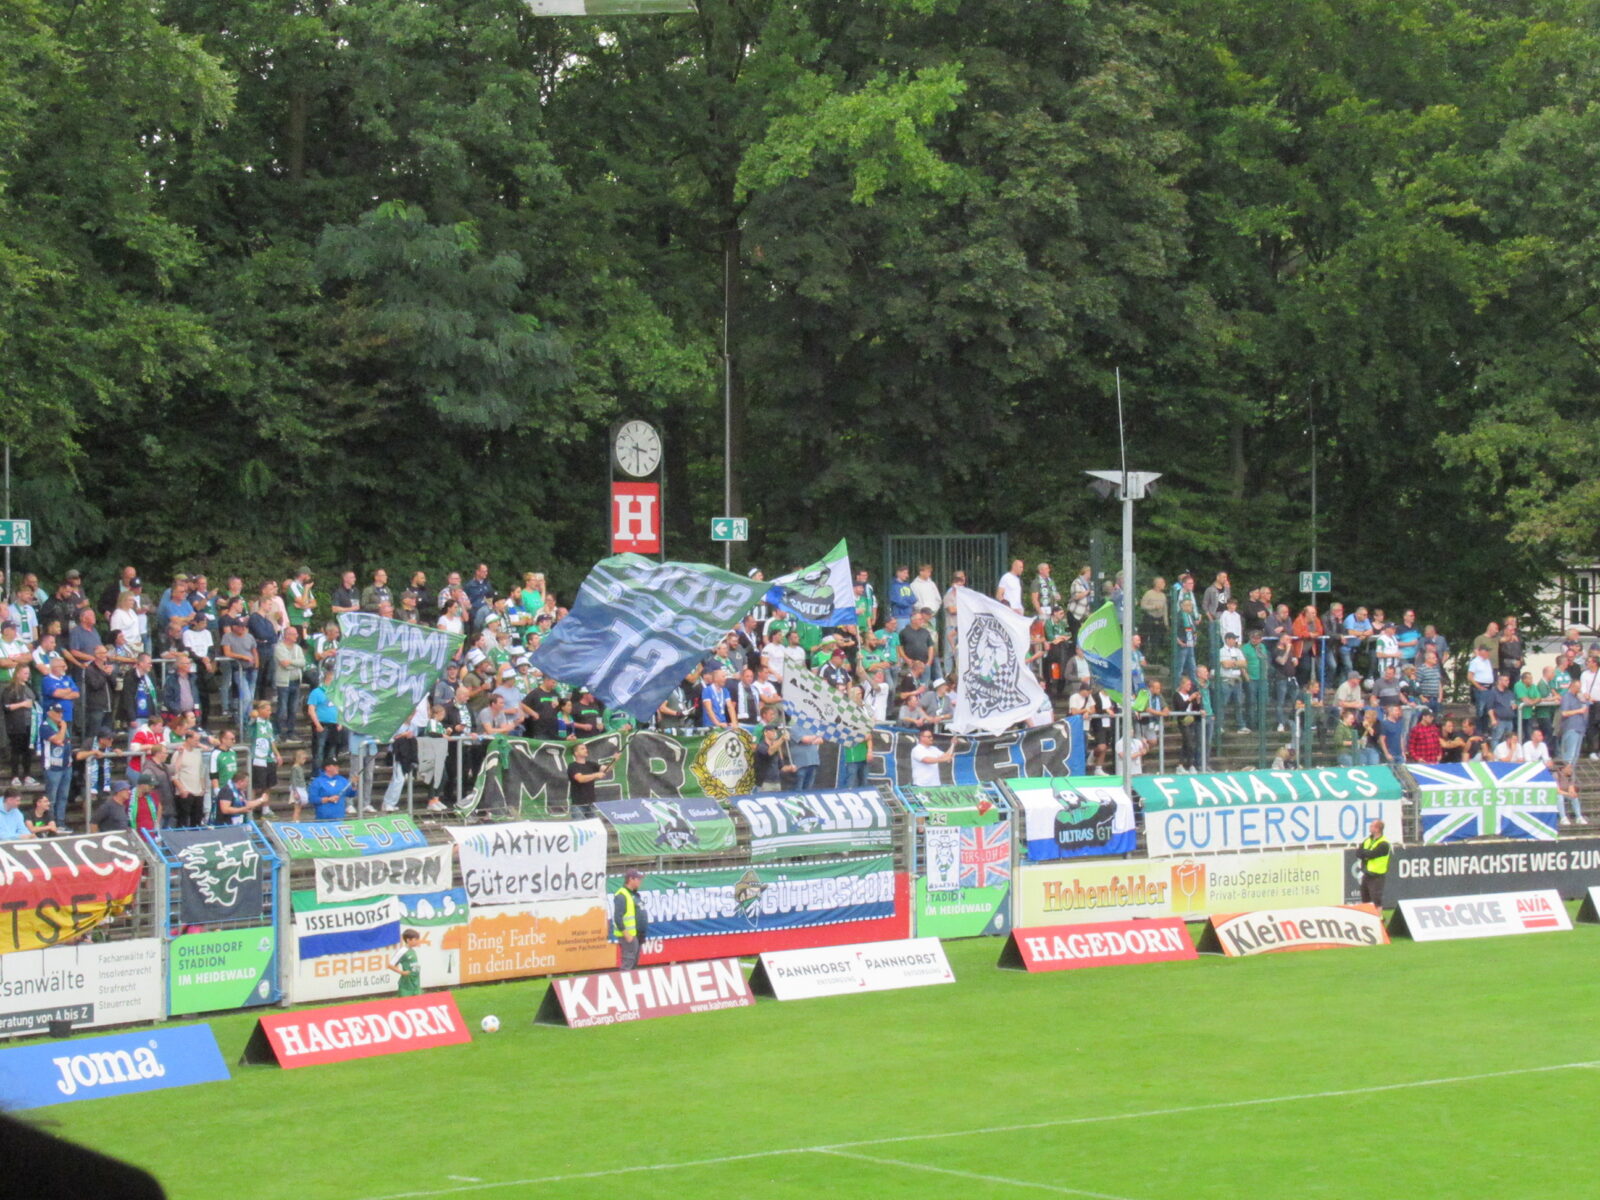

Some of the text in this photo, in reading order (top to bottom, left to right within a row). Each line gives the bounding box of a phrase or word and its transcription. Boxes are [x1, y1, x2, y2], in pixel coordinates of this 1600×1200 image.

[614, 494, 656, 540] H
[1153, 768, 1378, 807] FANATICS
[1431, 788, 1549, 807] LEICESTER
[737, 796, 788, 838] GT
[1164, 802, 1383, 850] GÜTERSLOH
[279, 818, 420, 852] RHEDA
[492, 828, 570, 857] Aktive
[1058, 823, 1114, 843] ULTRAS GT
[0, 835, 140, 887] ATICS
[1398, 858, 1430, 879] DER
[1433, 853, 1529, 876] EINFACHSTE
[1530, 851, 1568, 872] WEG
[321, 856, 441, 894] SUNDERN
[465, 862, 605, 898] Gütersloher
[1209, 867, 1320, 888] BrauSpezialitäten
[762, 870, 896, 915] GÜTERSLOH
[1043, 875, 1168, 912] Hohenfelder
[305, 904, 391, 931] ISSELHORST
[940, 903, 992, 915] HEIDEWALD
[510, 928, 546, 948] Farbe
[1024, 926, 1186, 962] HAGEDORN
[1225, 914, 1377, 955] Kleinemas
[178, 941, 243, 957] OHLENDORF
[99, 966, 152, 978] Insolvenzrecht
[178, 956, 226, 970] STADION
[468, 952, 556, 975] in dein Leben
[777, 953, 938, 979] PANNHORST PANNHORST
[0, 970, 85, 998] sanwälte
[99, 982, 137, 994] Strafrecht
[178, 967, 257, 987] IM HEIDEWALD
[338, 977, 362, 989] GmbH
[559, 957, 748, 1019] KAHMEN
[55, 1009, 62, 1020] A
[64, 1009, 79, 1021] bis
[81, 1006, 89, 1019] Z
[99, 998, 142, 1010] Steuerrecht
[689, 997, 749, 1013] www.kahmen.de
[275, 1004, 456, 1056] HAGEDORN
[569, 1009, 641, 1028] TransCargo GmbH
